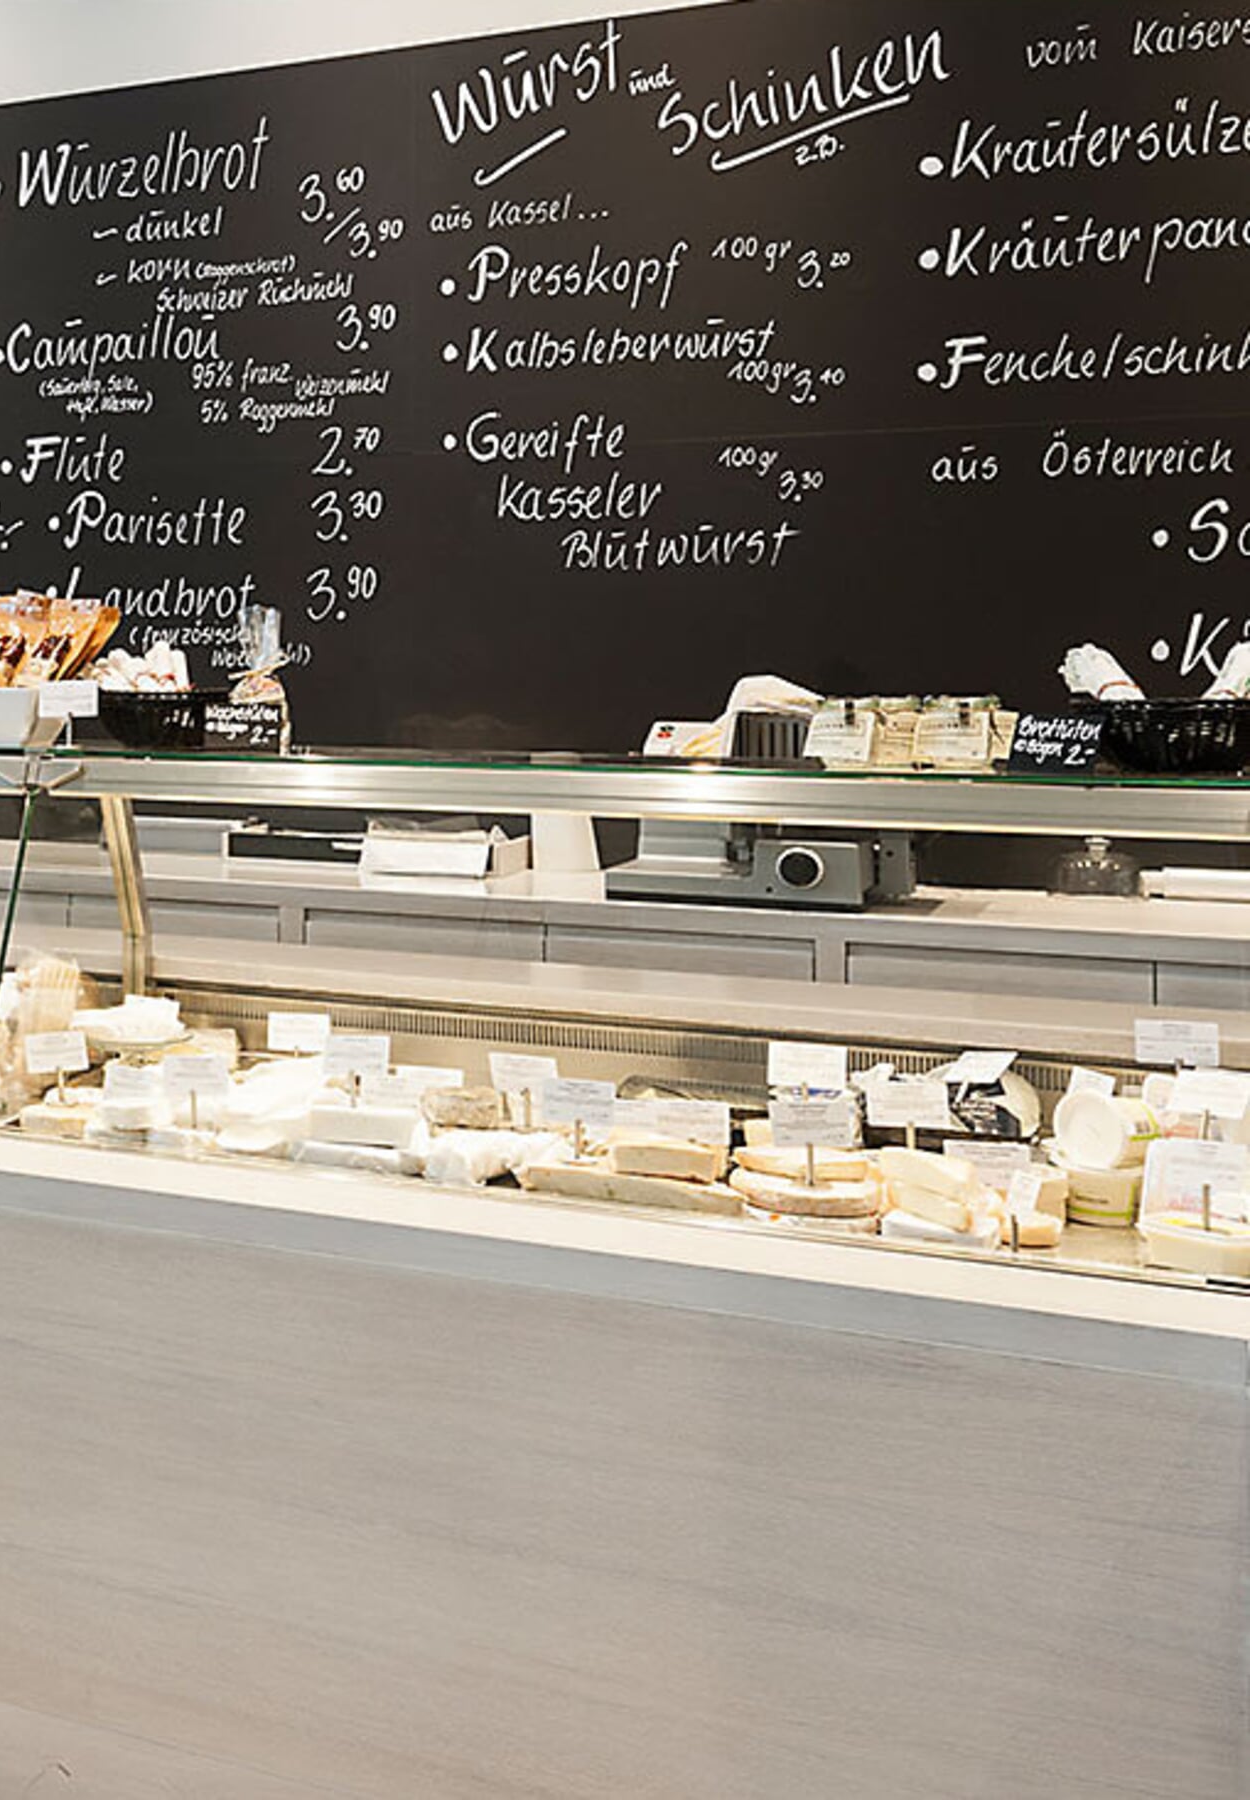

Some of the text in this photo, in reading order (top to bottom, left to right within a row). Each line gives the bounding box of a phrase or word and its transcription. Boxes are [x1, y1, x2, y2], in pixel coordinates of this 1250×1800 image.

[657, 29, 950, 155] Schinken
[467, 240, 690, 311] Presskopf
[712, 237, 757, 260] 100
[765, 239, 792, 273] gr
[192, 360, 234, 390] 95%
[200, 399, 230, 424] 5%
[466, 411, 625, 473] Gereifte
[1042, 427, 1234, 478] Österreich
[64, 490, 246, 549] Parisette
[497, 471, 663, 521] Kasseler
